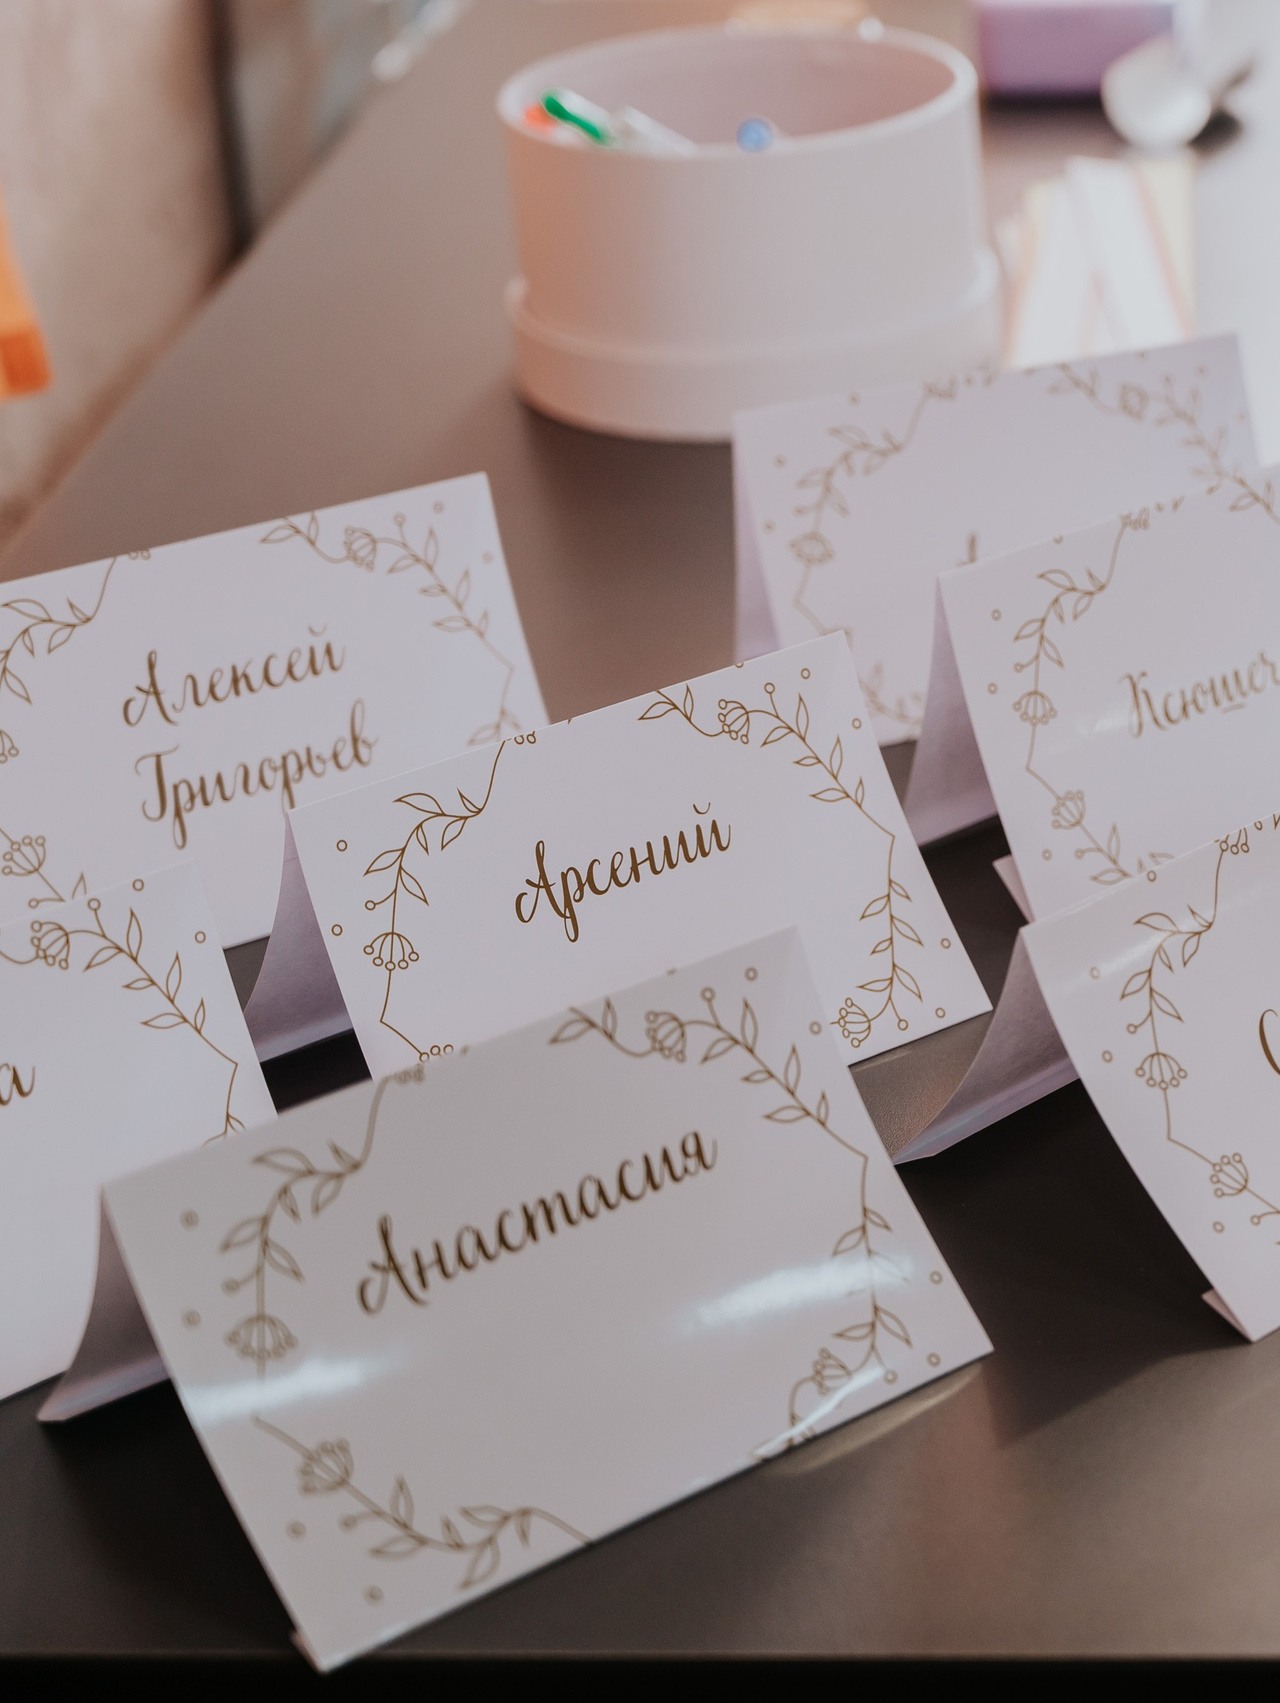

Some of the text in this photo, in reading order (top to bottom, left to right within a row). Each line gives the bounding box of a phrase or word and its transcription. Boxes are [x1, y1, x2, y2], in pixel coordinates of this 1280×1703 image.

[122, 624, 346, 727] Алексей
[135, 698, 380, 850] Григорьев
[515, 802, 732, 943] Арсений
[358, 1129, 719, 1315] Анастасия
